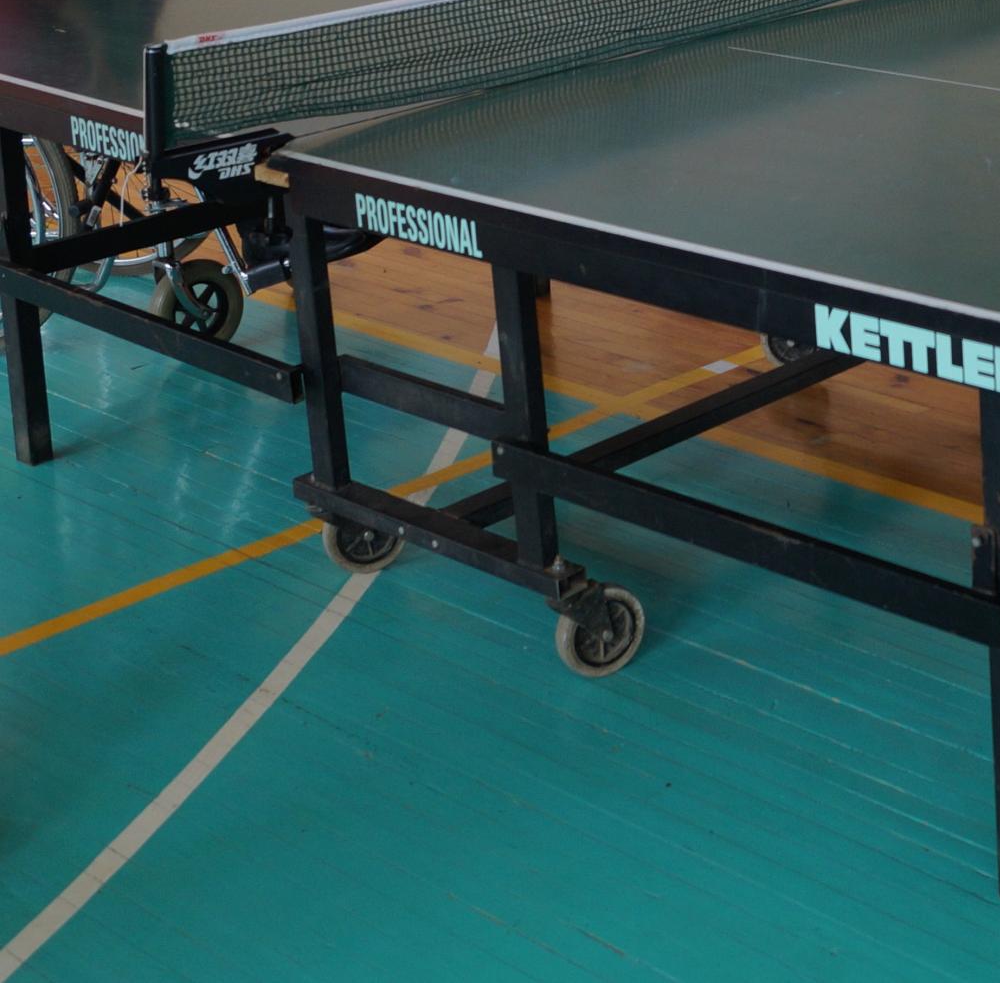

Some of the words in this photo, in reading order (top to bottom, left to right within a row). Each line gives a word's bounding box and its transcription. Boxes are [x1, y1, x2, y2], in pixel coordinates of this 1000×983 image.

[70, 115, 146, 161] PROFESSION
[217, 162, 255, 180] DHS
[354, 192, 484, 259] PROFESSIONAL
